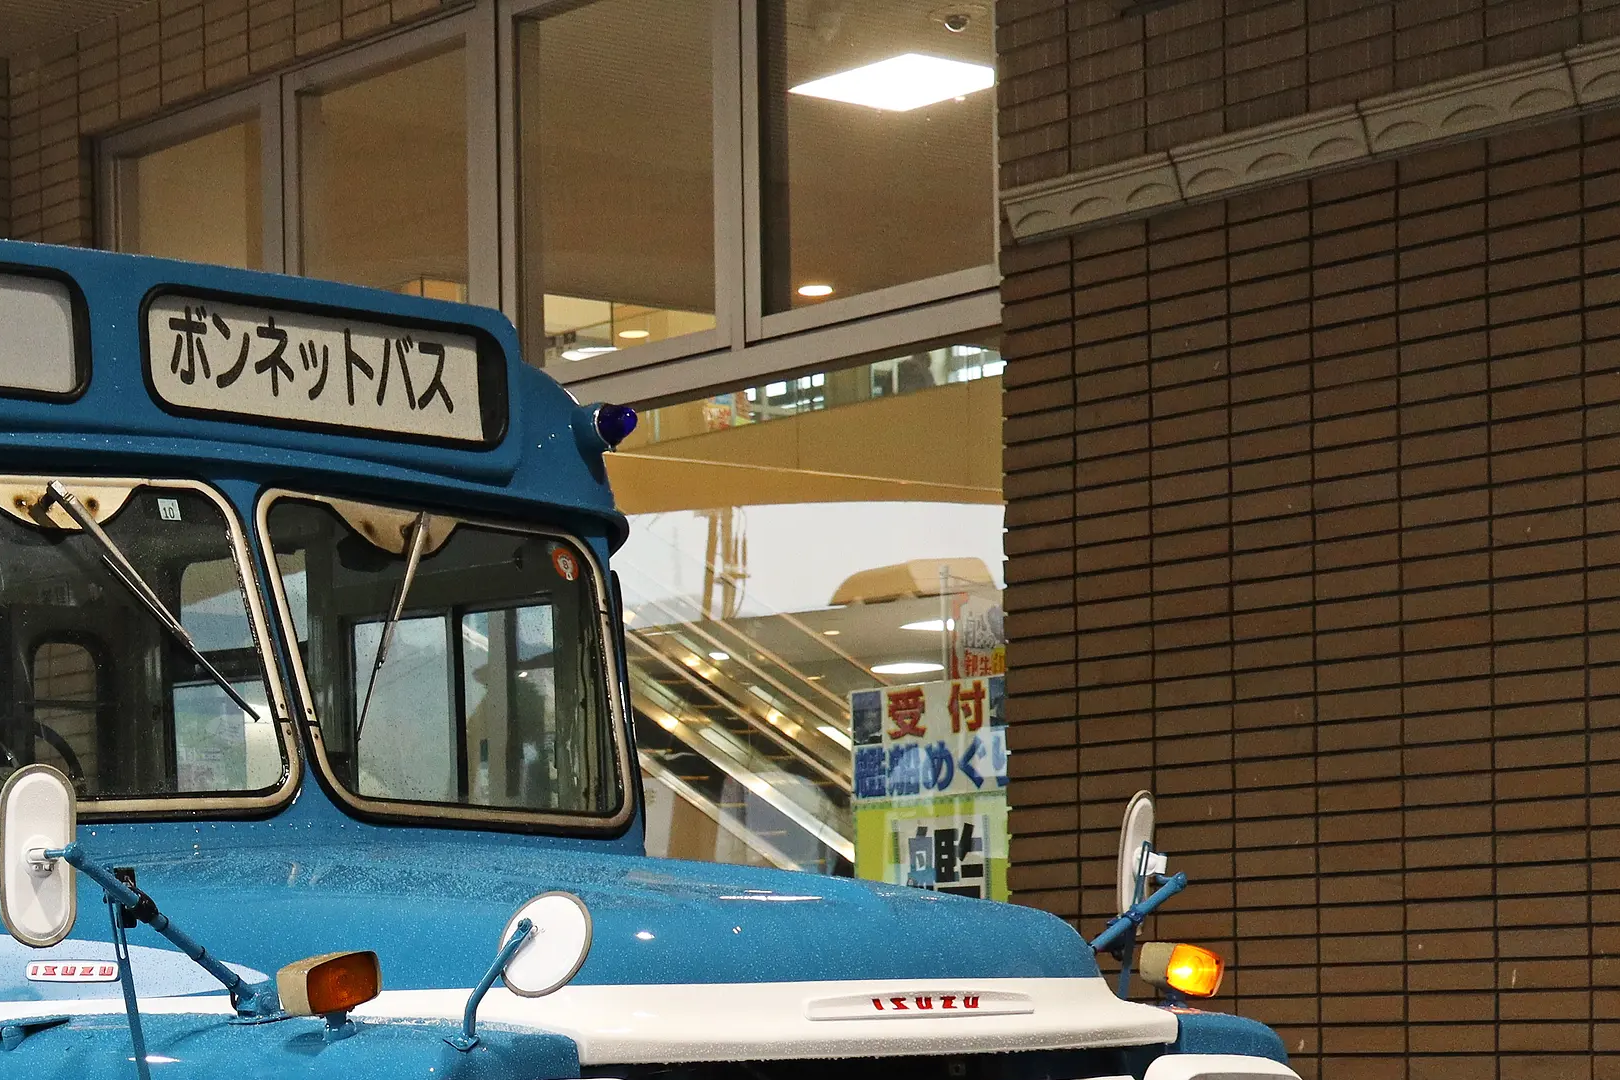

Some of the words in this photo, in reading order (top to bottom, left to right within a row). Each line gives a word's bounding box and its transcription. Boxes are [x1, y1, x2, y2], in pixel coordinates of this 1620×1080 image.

[168, 304, 455, 415] ボンネットバス
[163, 506, 175, 519] 10
[885, 680, 987, 741] 受付
[30, 965, 115, 977] ISUZU
[871, 995, 981, 1011] ISUZU
